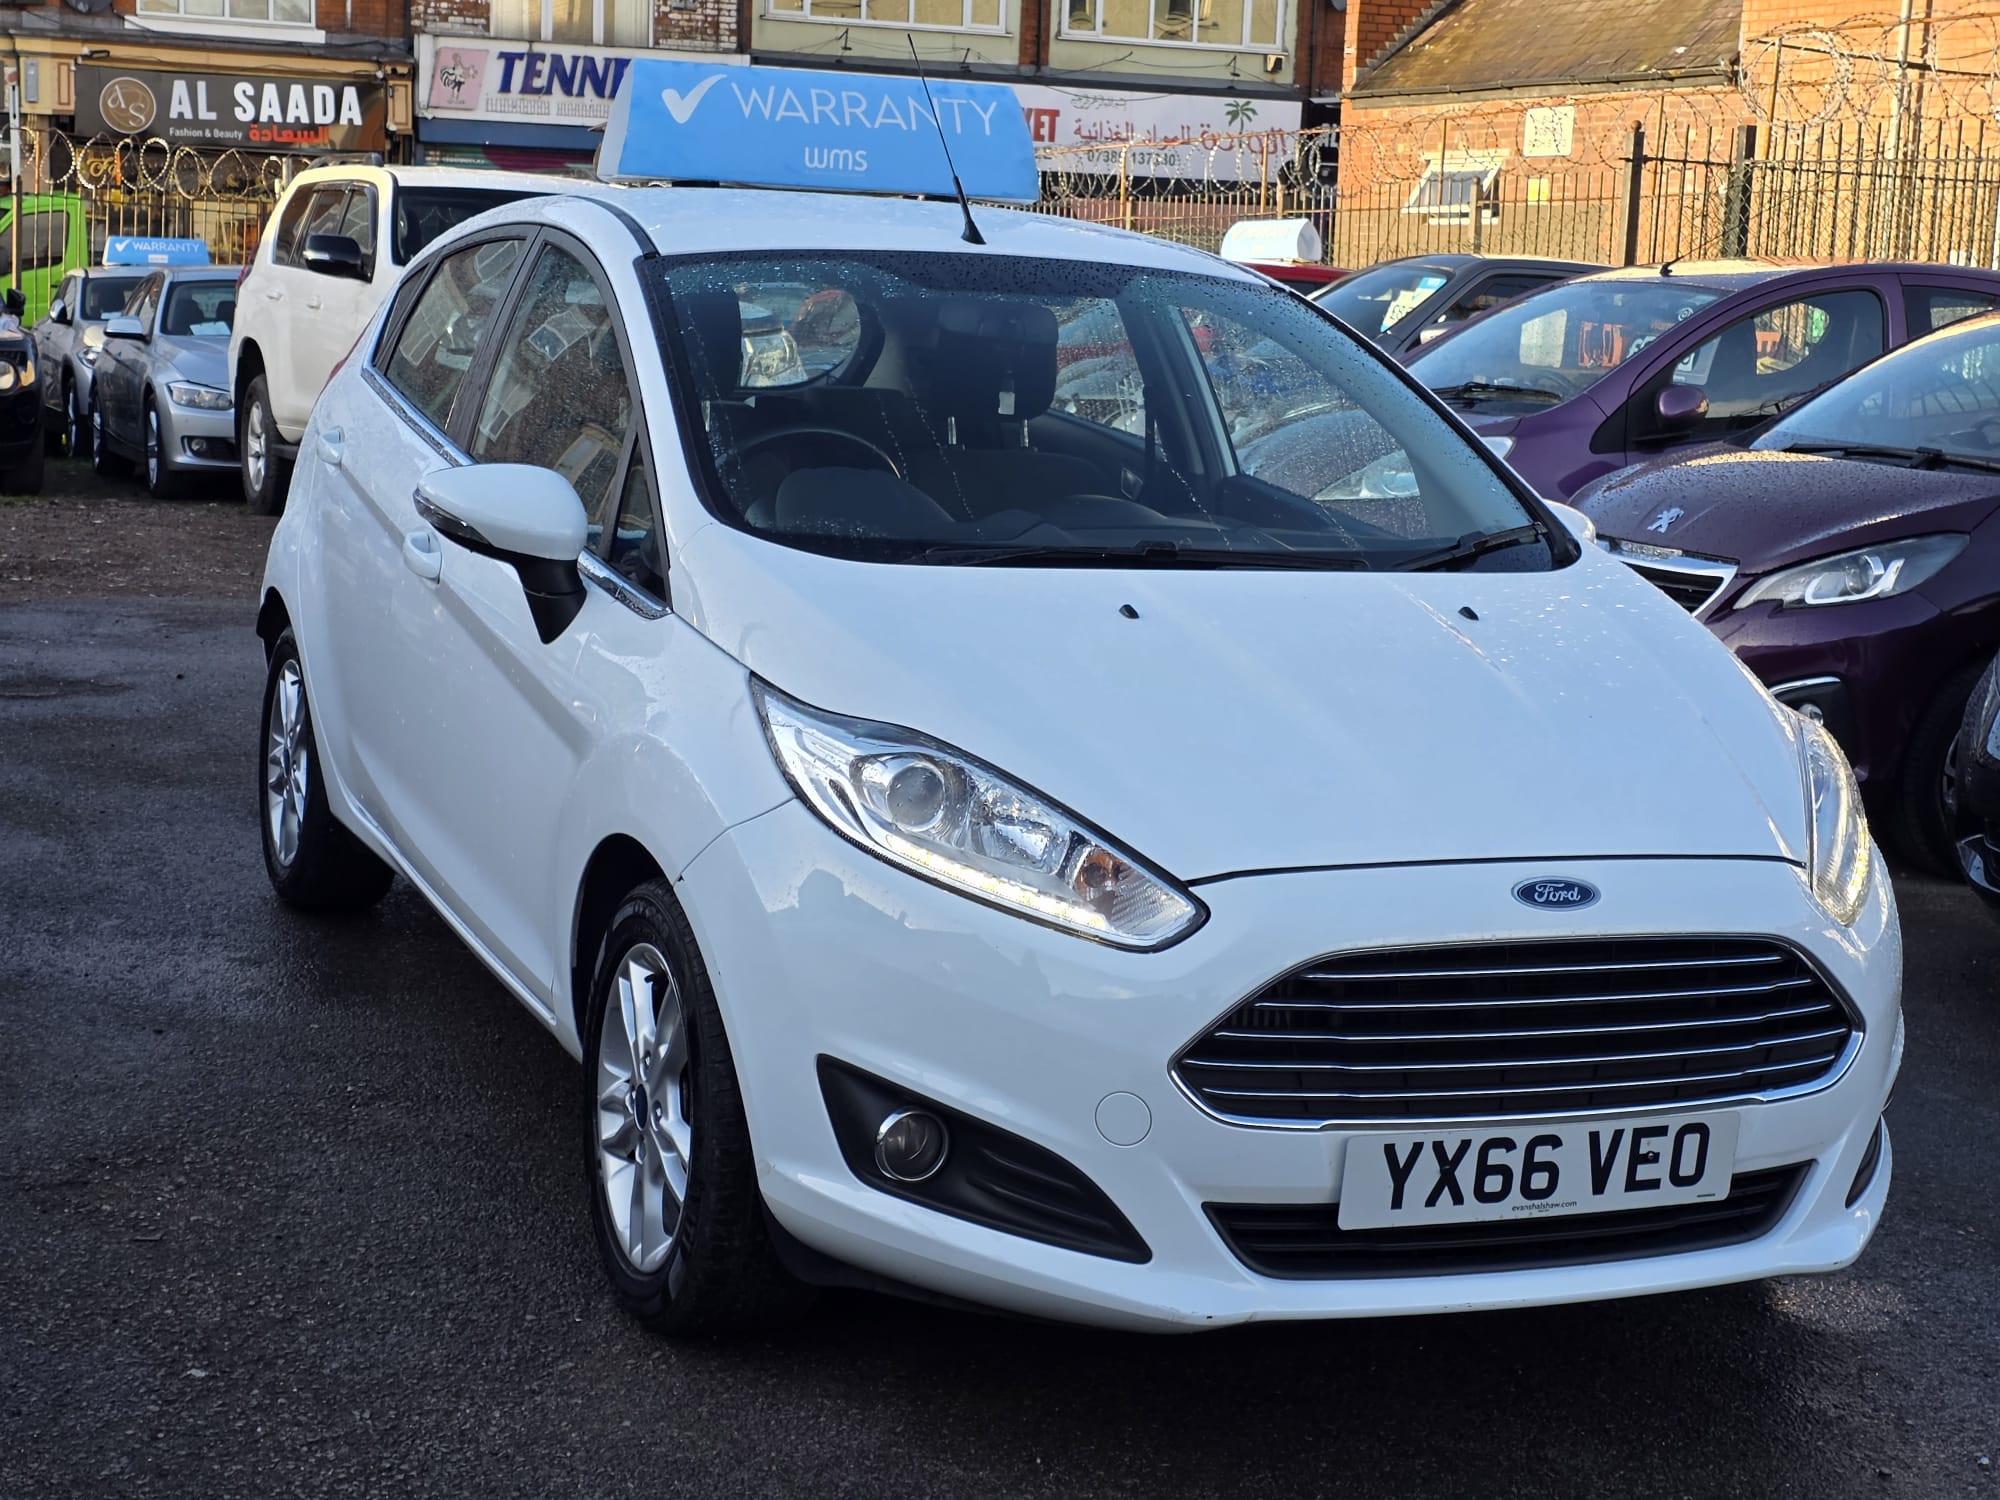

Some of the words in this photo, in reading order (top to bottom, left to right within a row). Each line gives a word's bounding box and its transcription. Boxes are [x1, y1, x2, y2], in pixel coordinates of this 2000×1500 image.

[169, 79, 217, 120] AL
[233, 81, 363, 126] SAADA
[731, 82, 998, 136] WARRANTY
[169, 126, 203, 138] Fashion
[204, 128, 211, 138] &
[213, 128, 242, 141] Beauty
[248, 124, 329, 143] السعادة
[804, 146, 868, 171] wms
[132, 241, 200, 253] WARRANTY
[1534, 883, 1581, 902] Ford
[1384, 1134, 1563, 1210] YX66
[1588, 1122, 1710, 1196] VEO
[1511, 1200, 1578, 1212] evanshalshaw.com
